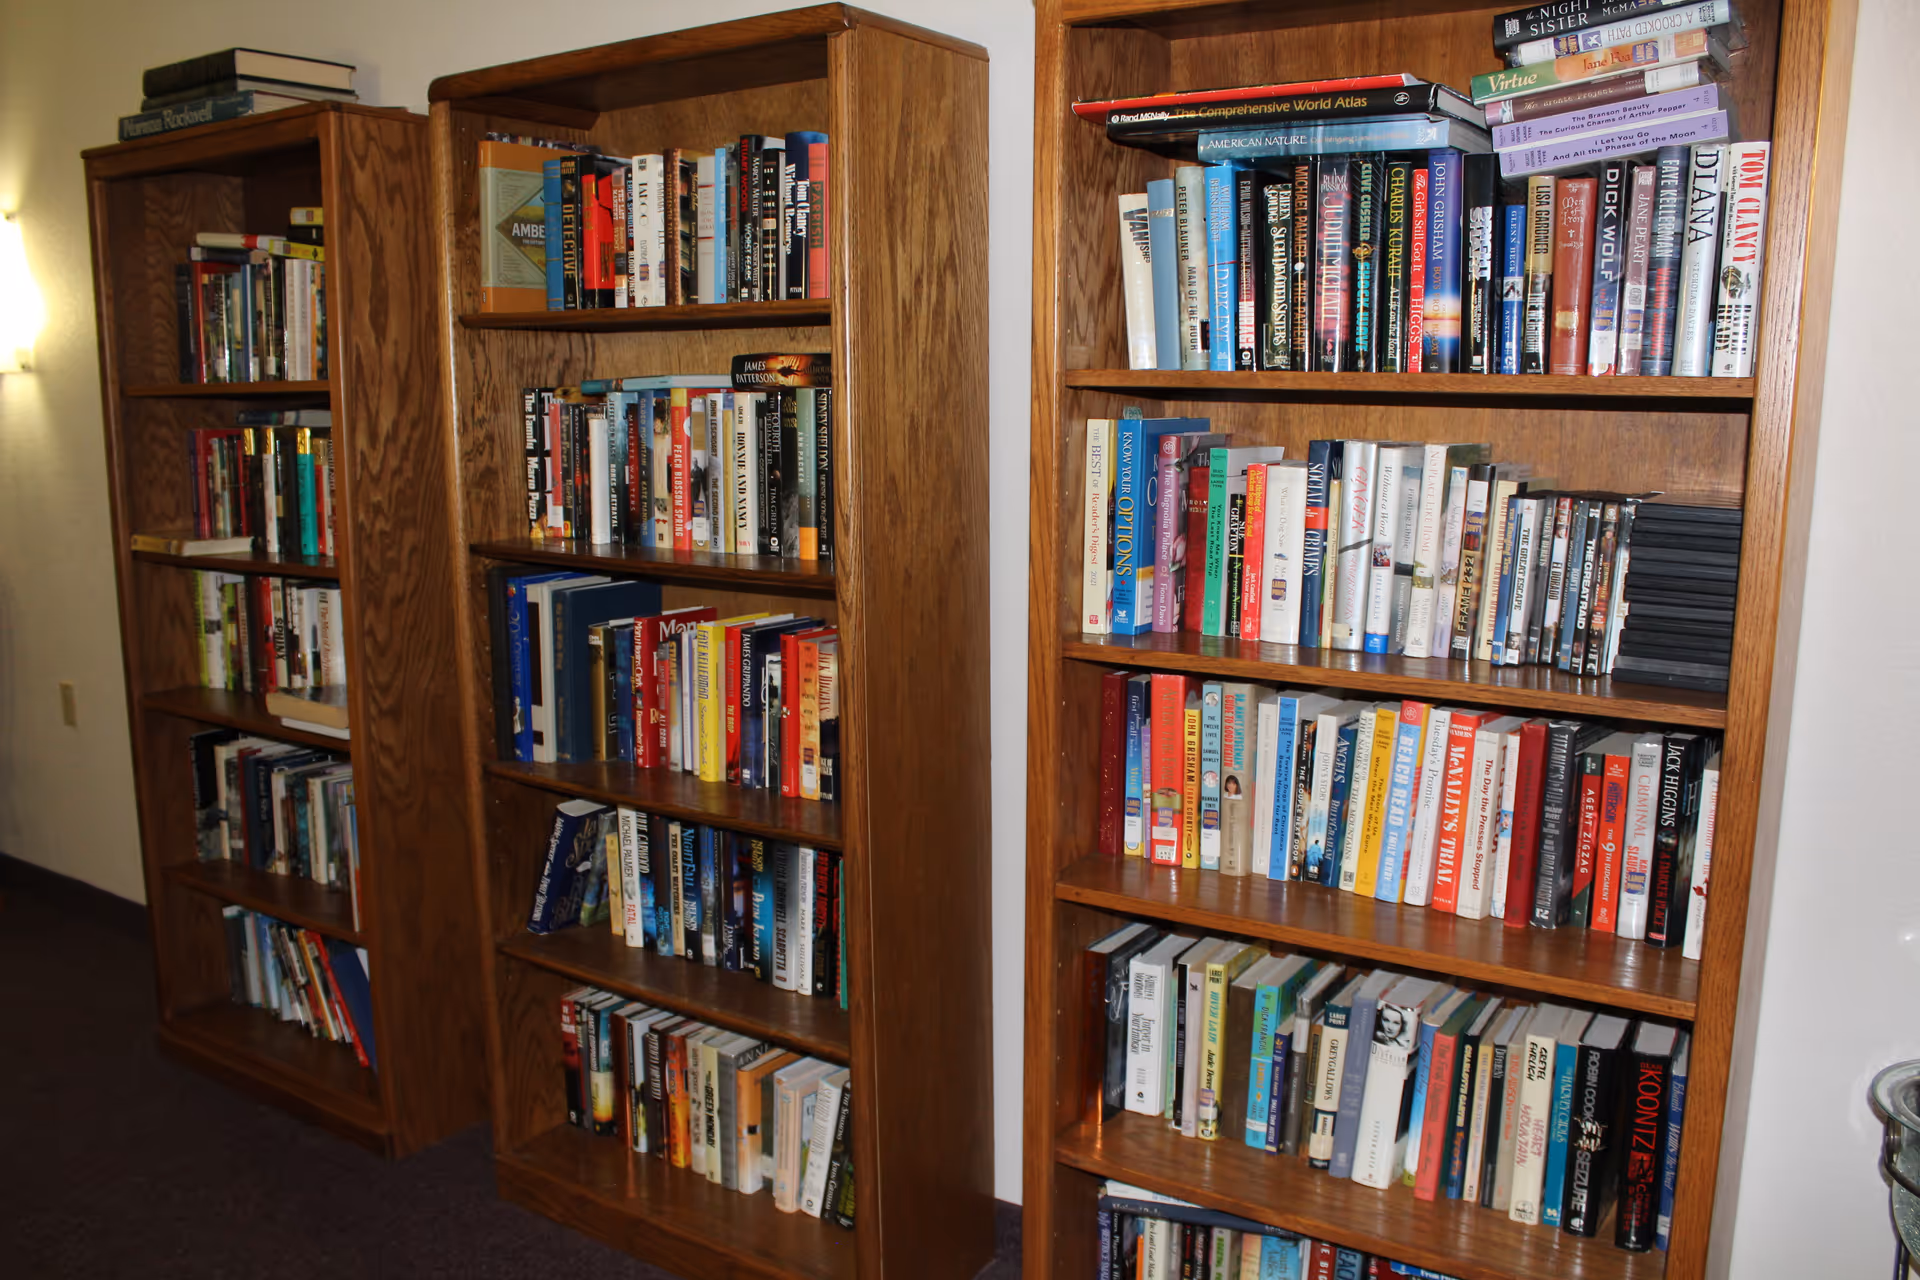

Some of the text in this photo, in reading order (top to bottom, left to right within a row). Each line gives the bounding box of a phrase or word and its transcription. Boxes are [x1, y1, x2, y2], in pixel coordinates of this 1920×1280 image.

[1530, 13, 1588, 37] SISTER
[1607, 11, 1693, 42] A CROOKED PATH
[162, 100, 214, 129] Rockwell
[1175, 96, 1369, 119] The Comprehensive World Atlas
[1487, 72, 1538, 93] Virtue
[1572, 103, 1650, 123] The Branson Beauty
[1207, 138, 1265, 150] AMERICAN
[1264, 135, 1309, 148] NATURE
[739, 138, 749, 213] STUART WOODS
[752, 156, 761, 217] MARCIA MULLER
[1265, 188, 1280, 225] GOUDGE
[1360, 163, 1372, 241] CLIVE CUSSLER
[1686, 150, 1720, 247] DIANA
[1731, 149, 1766, 265] TOM CLANCY
[782, 163, 796, 255] Without Remorse
[793, 179, 810, 239] Tom Clancy
[810, 183, 823, 249] PARRISH
[1122, 207, 1151, 264] VANISHED
[1178, 186, 1190, 262] PETER BLAUNER
[1208, 179, 1221, 242] BERNHARDT
[1219, 185, 1231, 231] WILLIAM
[1294, 165, 1309, 258] MICHAEL PALMER
[1387, 167, 1405, 280] CHARLES KURALT
[1432, 161, 1446, 262] JOHN GRISHAM
[1534, 186, 1550, 255] LISA GARDNER
[1600, 168, 1620, 282] DICK WOLF
[1632, 193, 1650, 265] JANE PEART
[1655, 159, 1680, 258] FAYE KELLERMAN
[563, 203, 577, 279] DETECTIVE
[743, 223, 752, 281] WORST FEARS
[1509, 210, 1518, 274] GLENN BECK
[1270, 226, 1290, 347] SUCH DEVOTED SISTERS
[1355, 261, 1370, 353] SHOCK WAVE
[1685, 263, 1700, 342] NICHOLAS DAVIES
[1409, 297, 1422, 344] HIGGS
[736, 373, 776, 384] PATTERSON
[744, 361, 767, 373] JAMES
[525, 393, 537, 450] The Family
[710, 398, 718, 418] JOHN
[771, 411, 782, 454] FOURTH
[817, 392, 830, 473] SIDNEY SHELDON
[527, 456, 540, 521] Mario Puzo
[673, 444, 684, 538] PEACH BLOSSOM SPRING
[738, 496, 748, 532] NANCY
[770, 485, 779, 536] TIM GREEN
[1115, 431, 1136, 577] KNOW YOUR OPTIONS
[1159, 467, 1175, 560] The Magnolia Palace
[1303, 462, 1325, 577] SOCIAL CRIMES
[1350, 466, 1369, 535] GINGER
[1229, 507, 1239, 552] GRAFTON
[1456, 556, 1475, 632] FRAME 232
[1513, 528, 1531, 611] THE GREAT ESCAPE
[1576, 538, 1597, 630] THE GREAT RAID
[1157, 582, 1169, 627] Fiona Davis
[274, 616, 287, 662] SPHINX
[696, 629, 709, 701] FAYE KELLERMAN
[741, 633, 751, 708] JAMES GRIPPANDO
[818, 652, 833, 714] JACK HIGGINS
[727, 704, 735, 735] THE DROP
[1186, 713, 1197, 783] JOHN GRISHAM
[1389, 735, 1415, 829] BEACH READ
[1422, 717, 1446, 810] Tuesday's Promise
[1479, 777, 1492, 796] Day
[1483, 759, 1494, 775] The
[1660, 742, 1685, 828] JACK HIGGINS
[1323, 735, 1351, 861] ANGELS BILLY GRAHAM
[1436, 743, 1467, 885] McNALLY'S TRIAL
[1480, 797, 1489, 812] the
[1633, 774, 1652, 840] CRIMINAL
[621, 815, 634, 879] MICHAEL PALMER
[638, 833, 650, 875] GARWOOD
[1476, 814, 1488, 850] Presses
[1579, 788, 1596, 875] AGENT ZIGZAG
[1471, 852, 1485, 892] Stopped
[626, 903, 637, 926] FATAL
[775, 928, 788, 972] SCARPETTA
[1322, 1038, 1340, 1101] GREYGALLOWS
[1525, 1041, 1539, 1082] EHRLICH
[1536, 1046, 1549, 1081] GRETEL
[1582, 1049, 1600, 1121] ROBIN COOK
[704, 1085, 716, 1150] GREEN MONDAY
[836, 1106, 851, 1142] SUMMONS
[1514, 1103, 1533, 1169] MOUNTAIN
[1530, 1119, 1545, 1158] HEART
[1631, 1069, 1662, 1151] KOONTZ
[1569, 1150, 1592, 1214] SEIZURE
